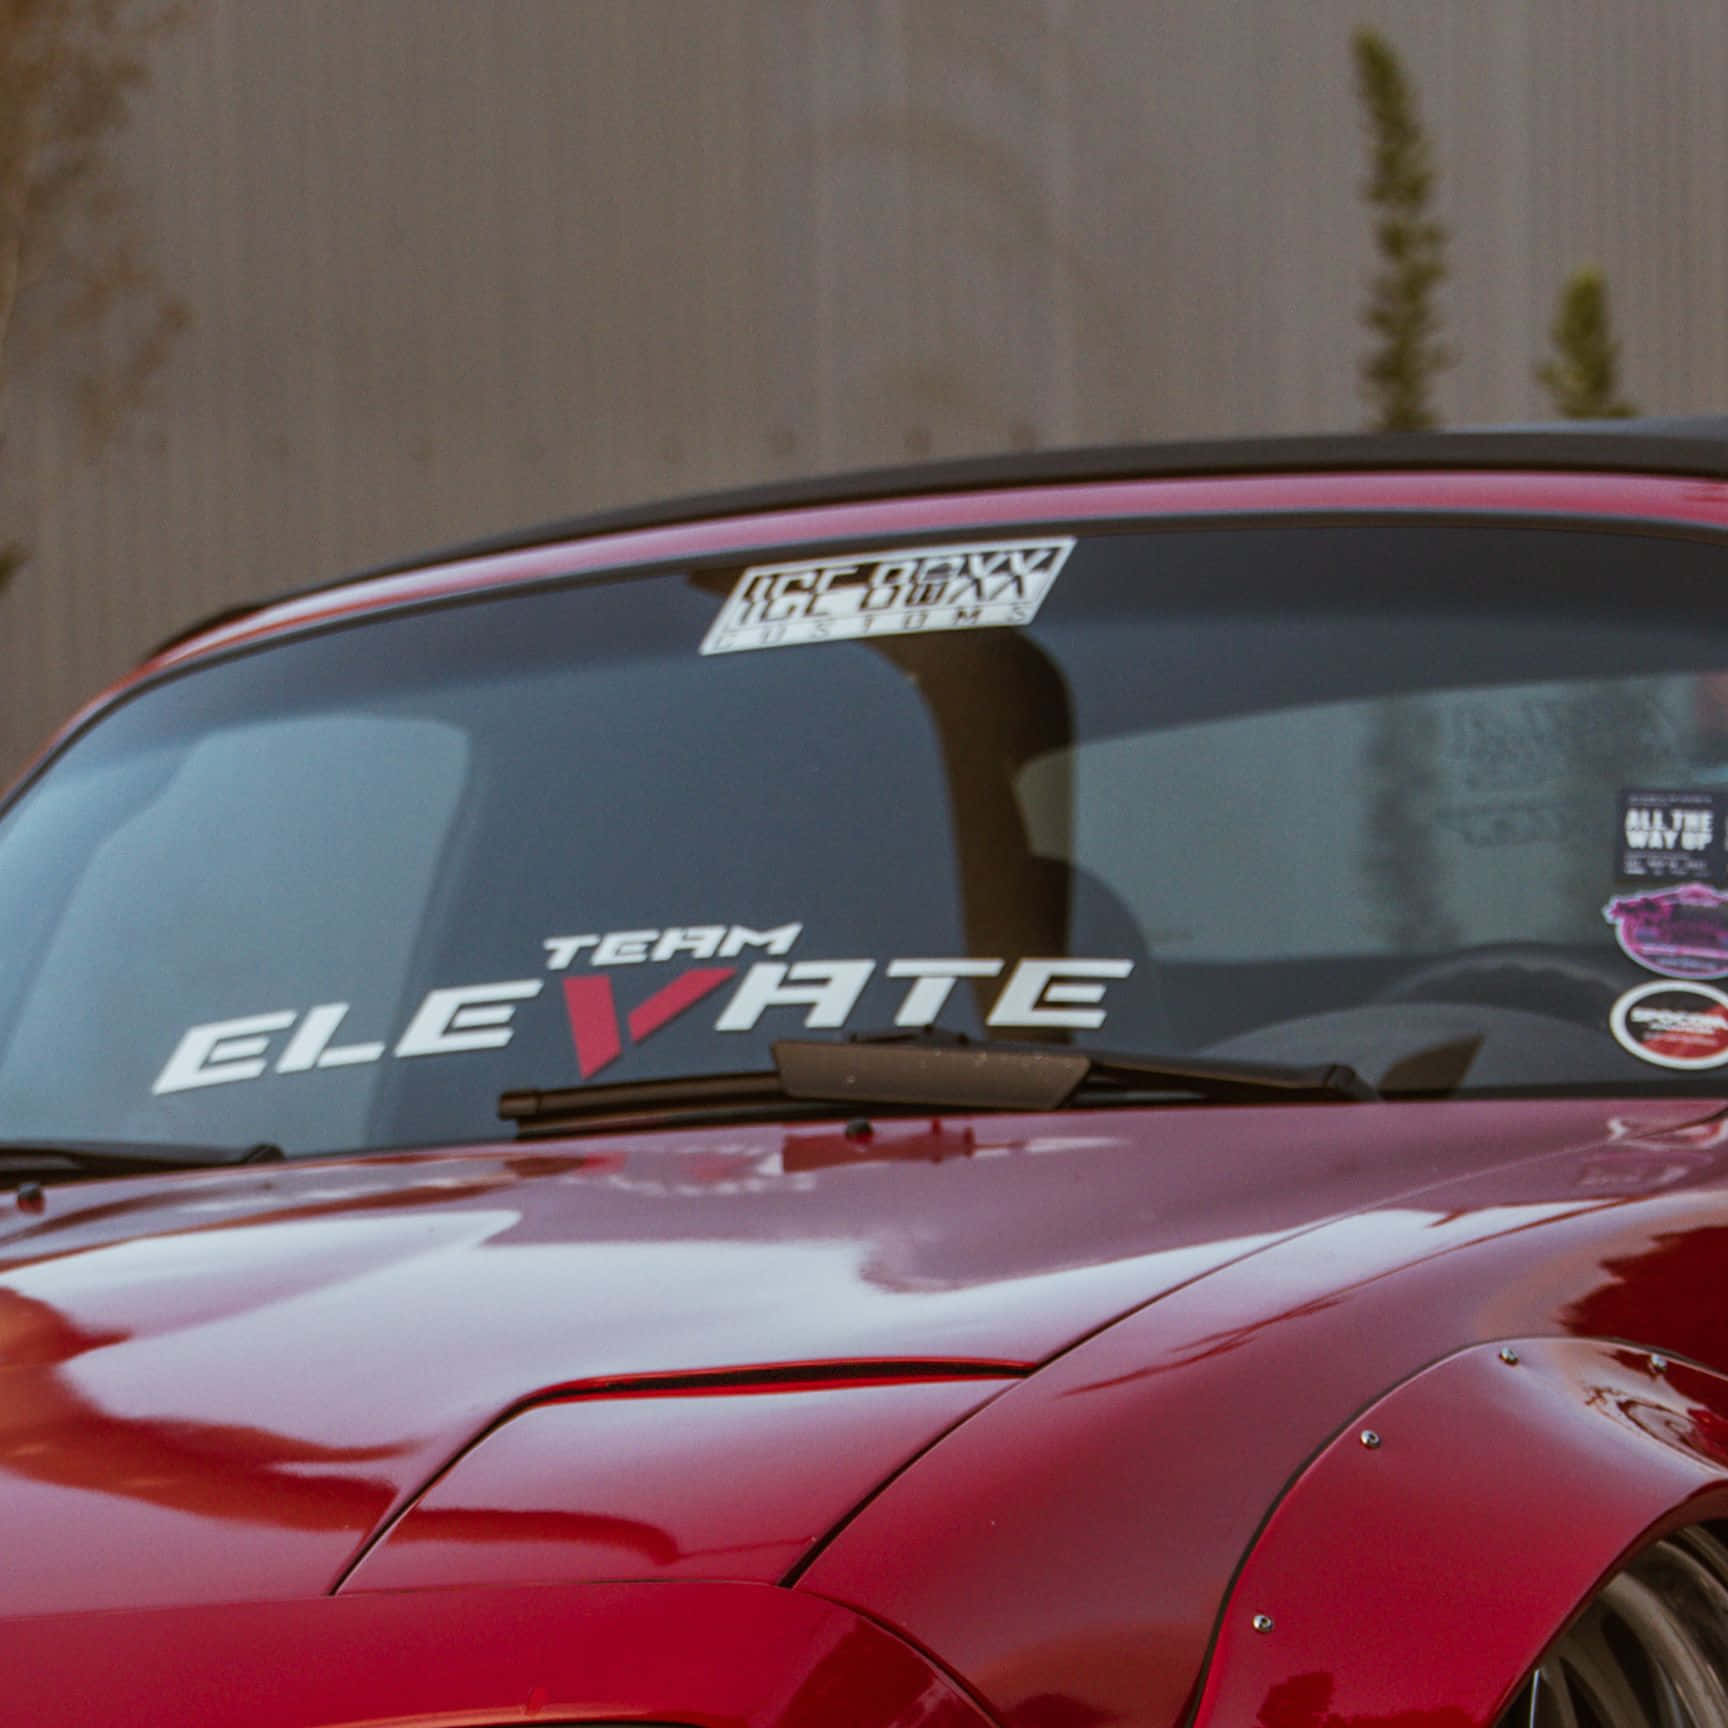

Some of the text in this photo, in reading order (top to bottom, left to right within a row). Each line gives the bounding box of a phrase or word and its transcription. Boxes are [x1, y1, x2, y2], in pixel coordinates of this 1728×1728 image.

[1625, 808, 1713, 831] ALL THE
[1626, 831, 1678, 849] WAY
[1681, 831, 1712, 850] UP
[543, 921, 802, 969] TEAM
[152, 957, 1134, 1097] ELEVATE
